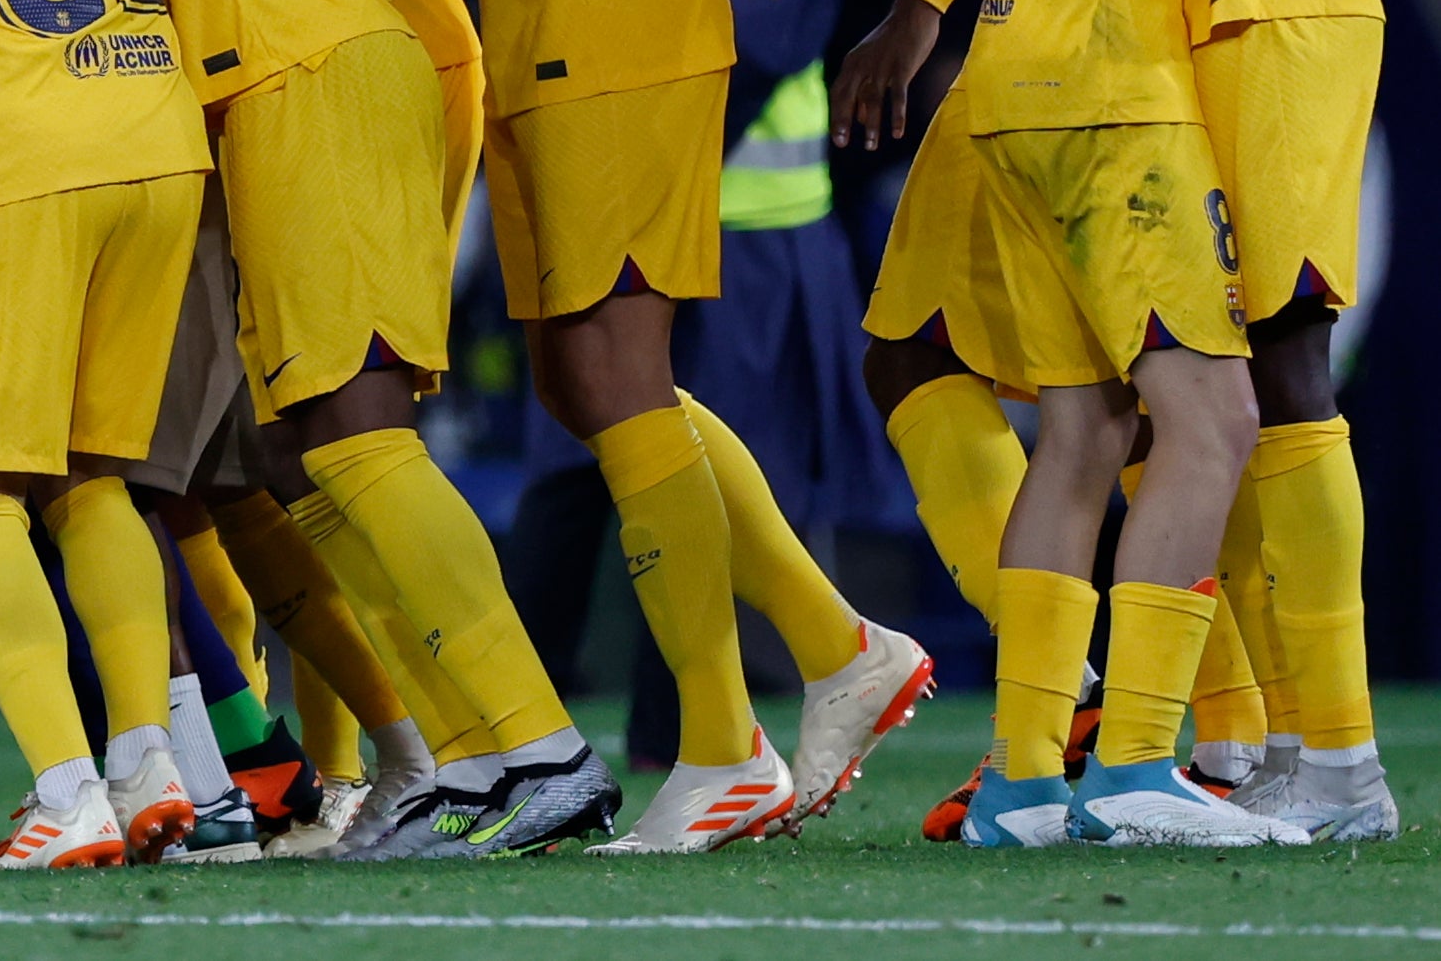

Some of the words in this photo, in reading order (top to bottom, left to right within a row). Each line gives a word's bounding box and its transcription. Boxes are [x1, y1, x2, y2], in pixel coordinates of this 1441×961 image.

[108, 34, 170, 51] UNHCR
[114, 50, 174, 70] ACNUR
[1203, 188, 1240, 276] 8
